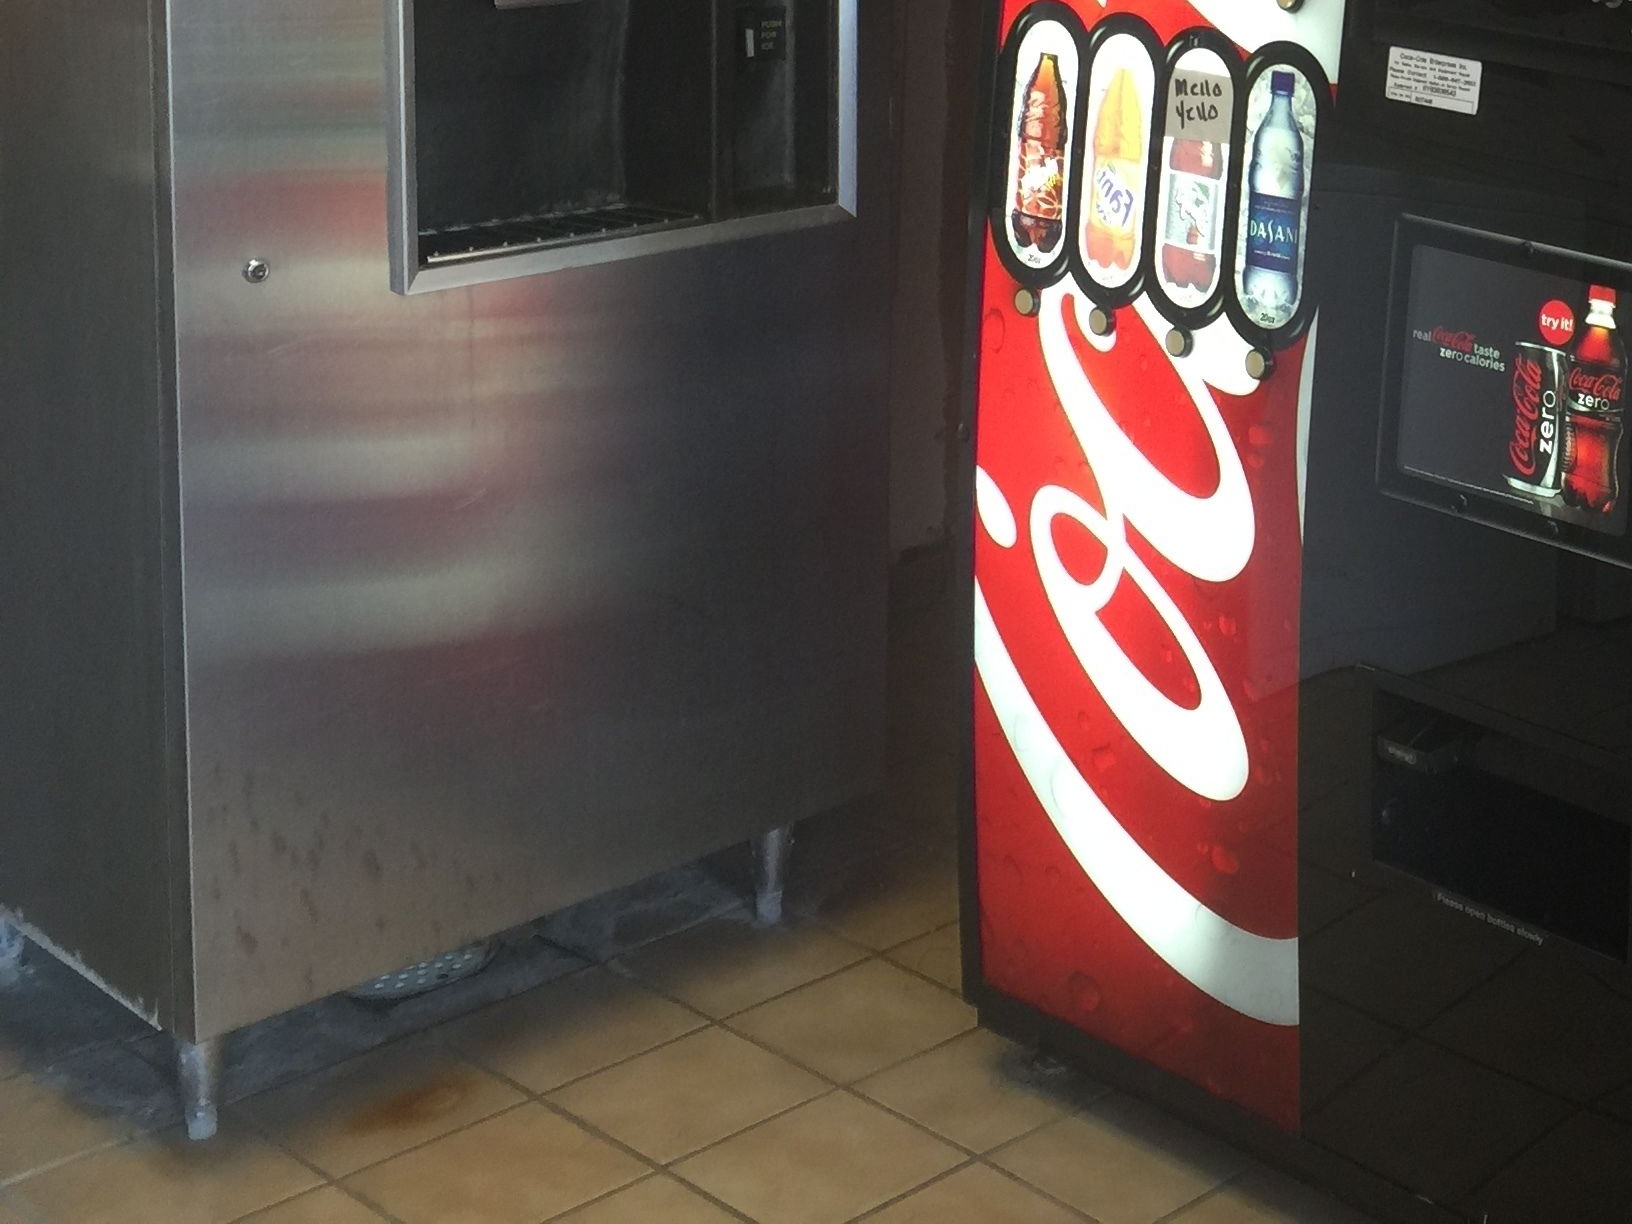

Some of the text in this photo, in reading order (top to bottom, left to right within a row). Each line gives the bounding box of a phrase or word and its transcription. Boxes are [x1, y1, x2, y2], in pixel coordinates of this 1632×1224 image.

[1250, 219, 1298, 244] DASANI
[1541, 313, 1574, 332] try it!
[1412, 328, 1432, 342] real
[1473, 343, 1500, 360] taste
[1439, 347, 1505, 373] zero calories
[1568, 366, 1623, 402] Coca-Cola
[1509, 353, 1542, 476] Coca-Cola
[1577, 391, 1610, 411] zero
[1539, 390, 1557, 455] zero
